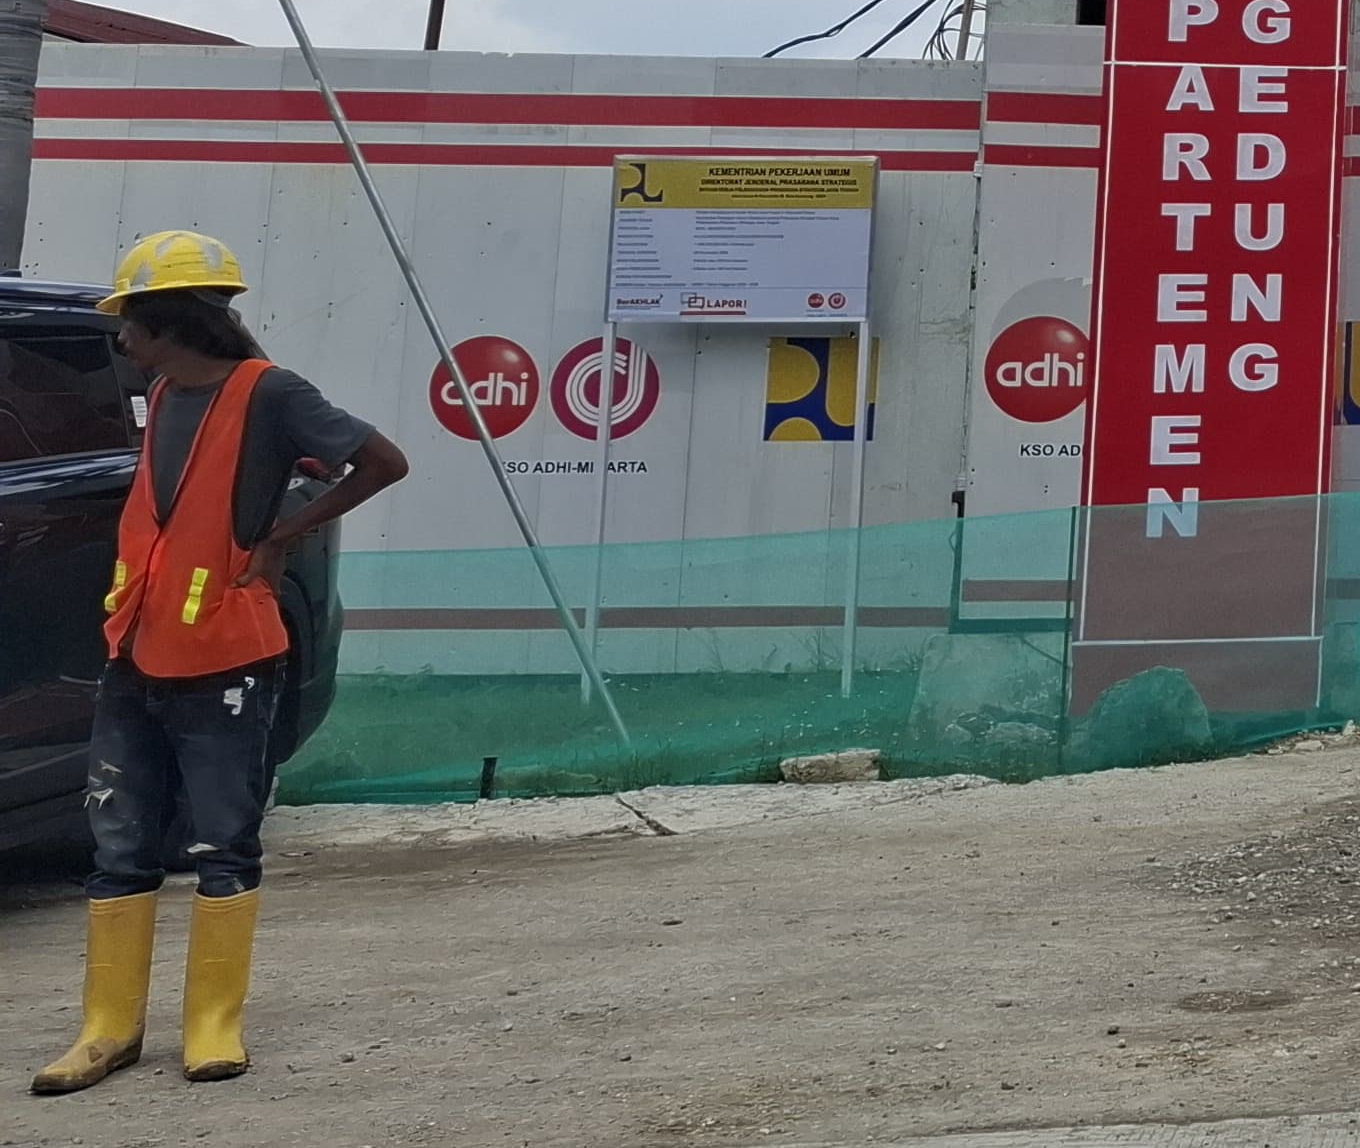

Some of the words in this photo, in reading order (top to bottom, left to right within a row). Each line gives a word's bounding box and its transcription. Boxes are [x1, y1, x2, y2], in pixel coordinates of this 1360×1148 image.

[768, 168, 822, 176] PEKERJAAN
[996, 352, 1085, 387] adhi
[1020, 445, 1054, 456] KSO
[501, 461, 529, 474] SO
